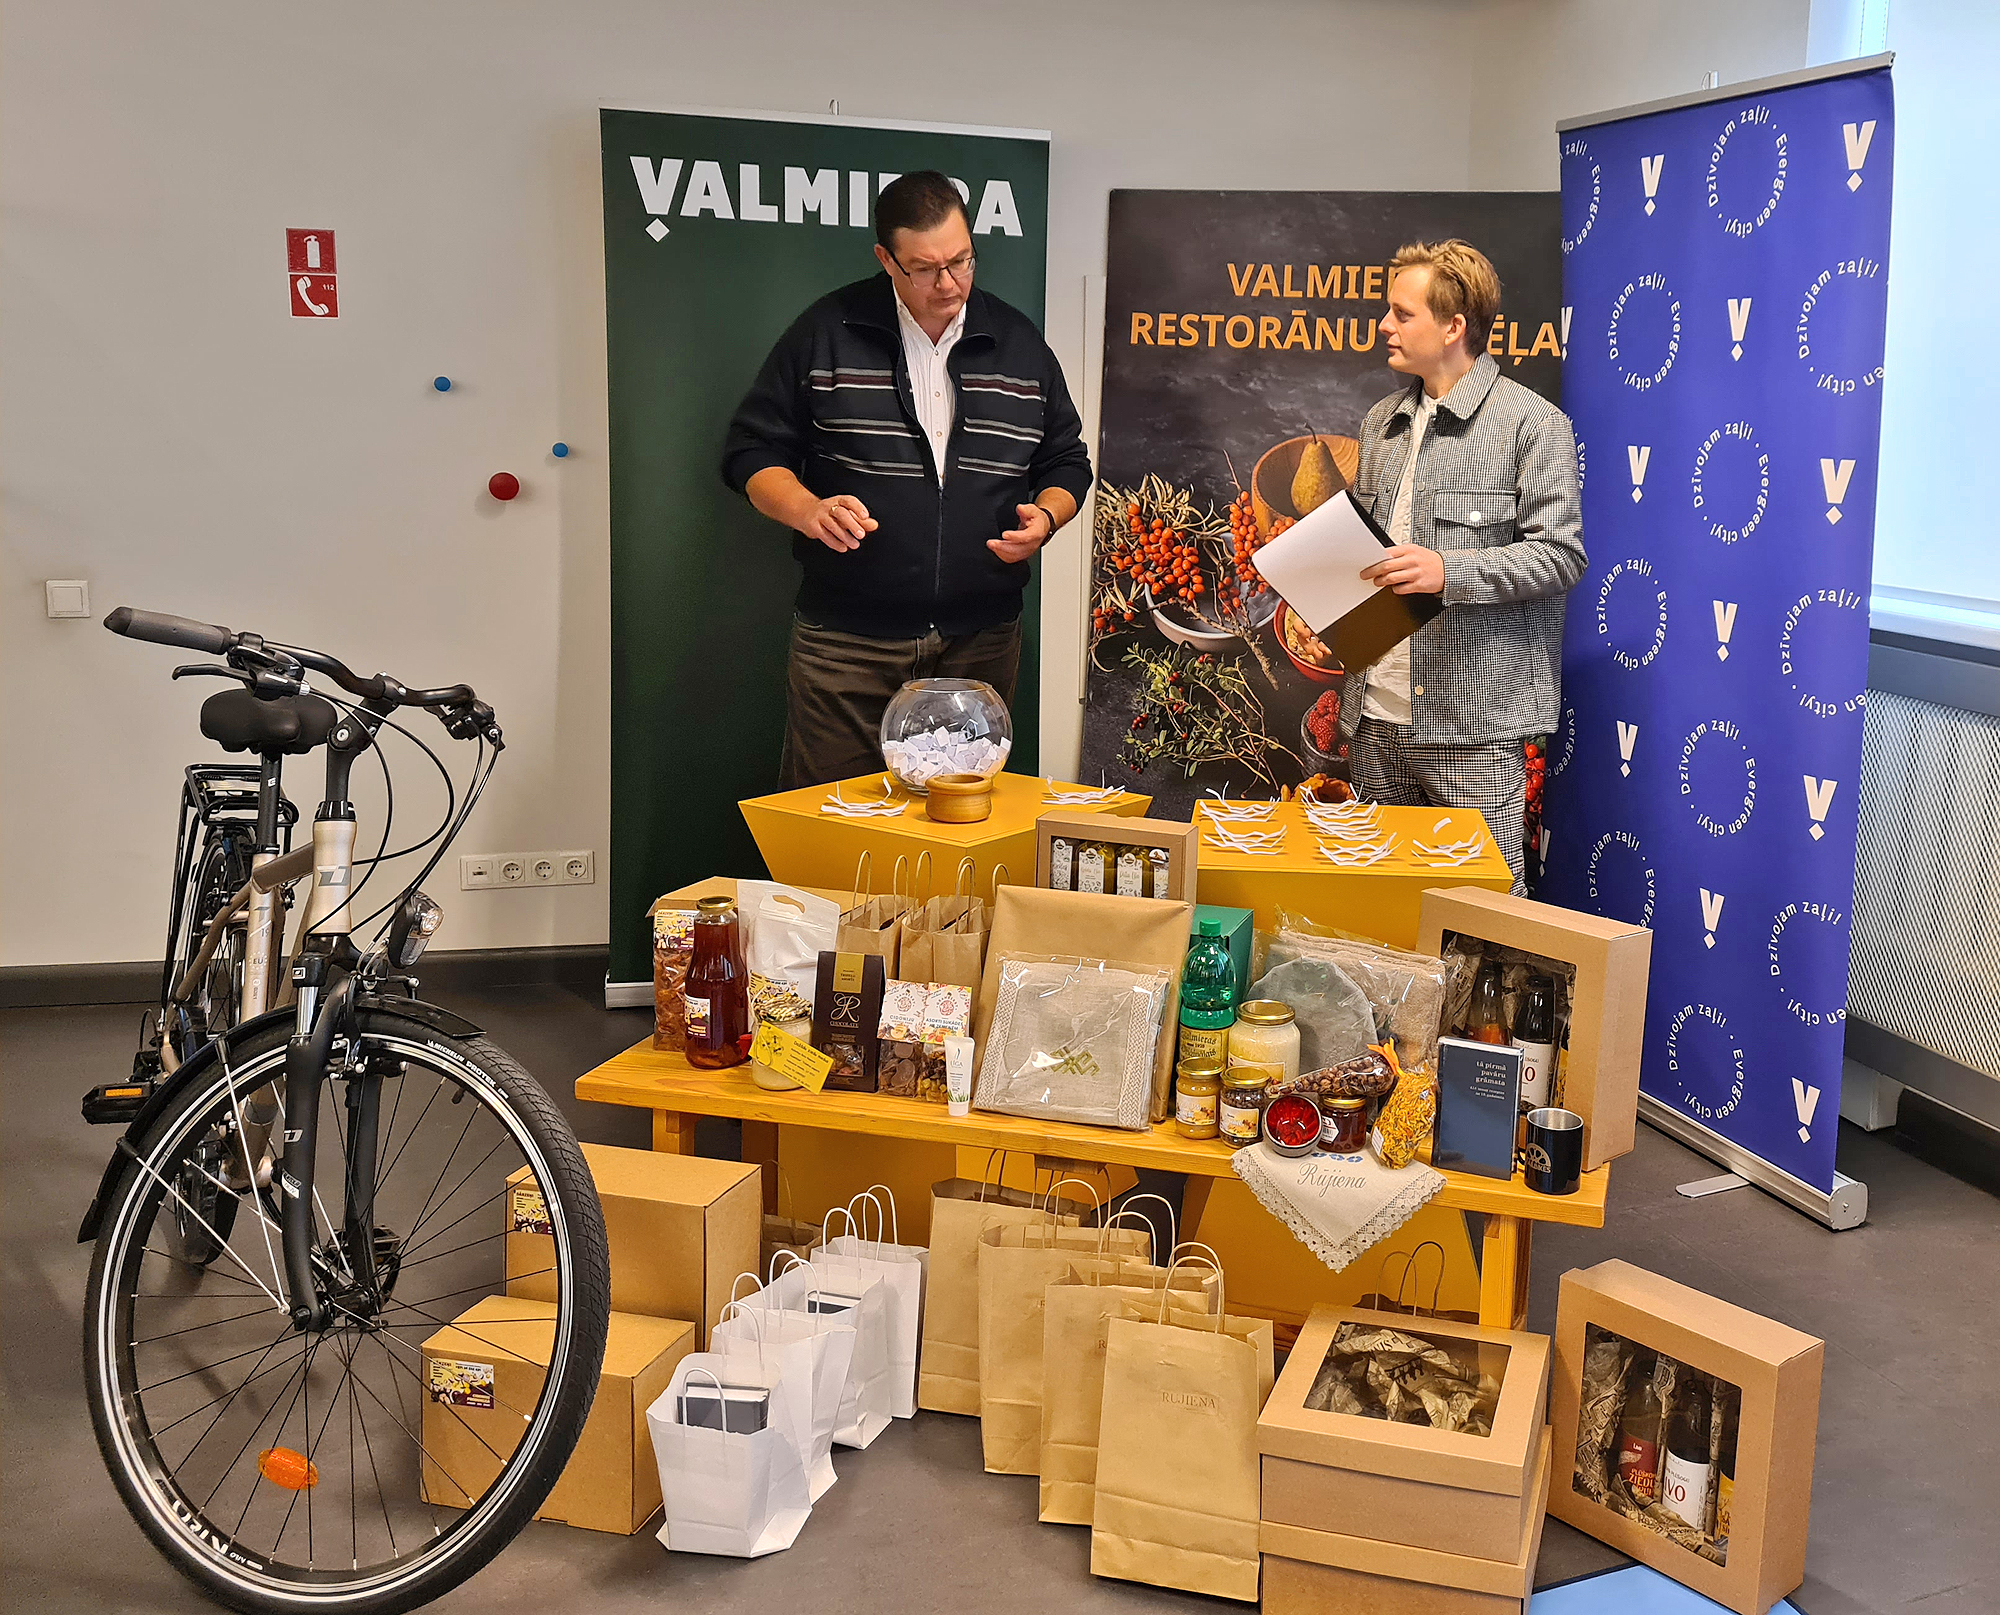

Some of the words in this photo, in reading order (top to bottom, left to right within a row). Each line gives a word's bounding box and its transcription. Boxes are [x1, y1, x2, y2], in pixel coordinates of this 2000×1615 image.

[629, 155, 1024, 242] VALMIA
[1706, 120, 1736, 208] Dzīvojam
[1756, 132, 1788, 227] Evergreen
[1576, 163, 1600, 245] Evergreen
[1227, 262, 1397, 300] VALMIE
[1796, 269, 1832, 359] Dzīvojam
[1130, 310, 1376, 352] RESTORĀNU
[1486, 314, 1561, 366] ĒĻA
[1608, 282, 1635, 360] Dzīvojam
[1654, 300, 1681, 384] Evergreen
[1577, 442, 1586, 490] Everg
[1691, 428, 1721, 509] Dzīvojam
[1741, 453, 1770, 539] Evergreen
[1596, 562, 1623, 635] Dzīvojam
[1642, 590, 1668, 667] Evergreen
[1780, 593, 1812, 675] Dzīvojam
[1678, 722, 1707, 795] Dzīvojam
[1728, 757, 1756, 835] Evergreen
[1587, 832, 1612, 898] Dzīvojam
[1640, 869, 1655, 928] Evergre
[1767, 902, 1797, 976] Dzīvojam
[434, 1043, 465, 1062] MICHELIN
[1666, 1005, 1694, 1071] Dzīvojam
[1715, 1048, 1745, 1119] Evergreen
[1297, 1163, 1366, 1198] Rūjiena
